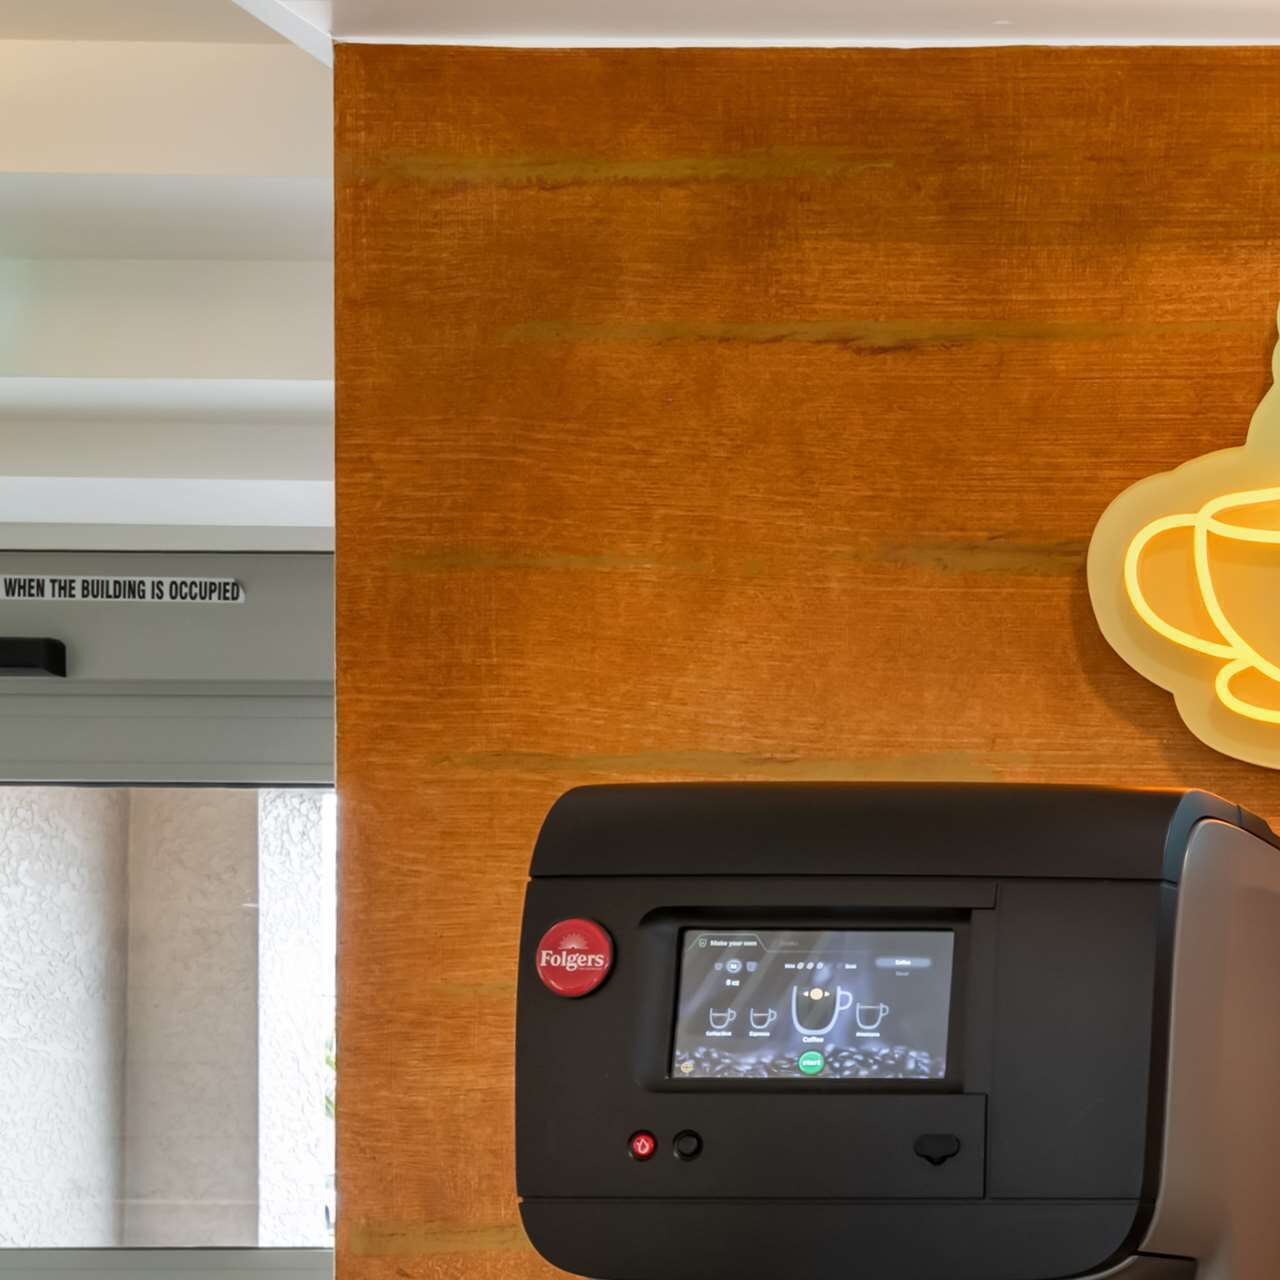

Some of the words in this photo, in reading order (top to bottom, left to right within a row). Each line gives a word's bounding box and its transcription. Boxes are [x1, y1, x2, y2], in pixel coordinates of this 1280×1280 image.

[3, 578, 45, 598] WHEN
[50, 578, 76, 598] THE
[81, 579, 146, 600] BUILDING
[151, 580, 164, 600] IS
[169, 581, 240, 601] OCCUPIED
[540, 950, 604, 971] Folgers
